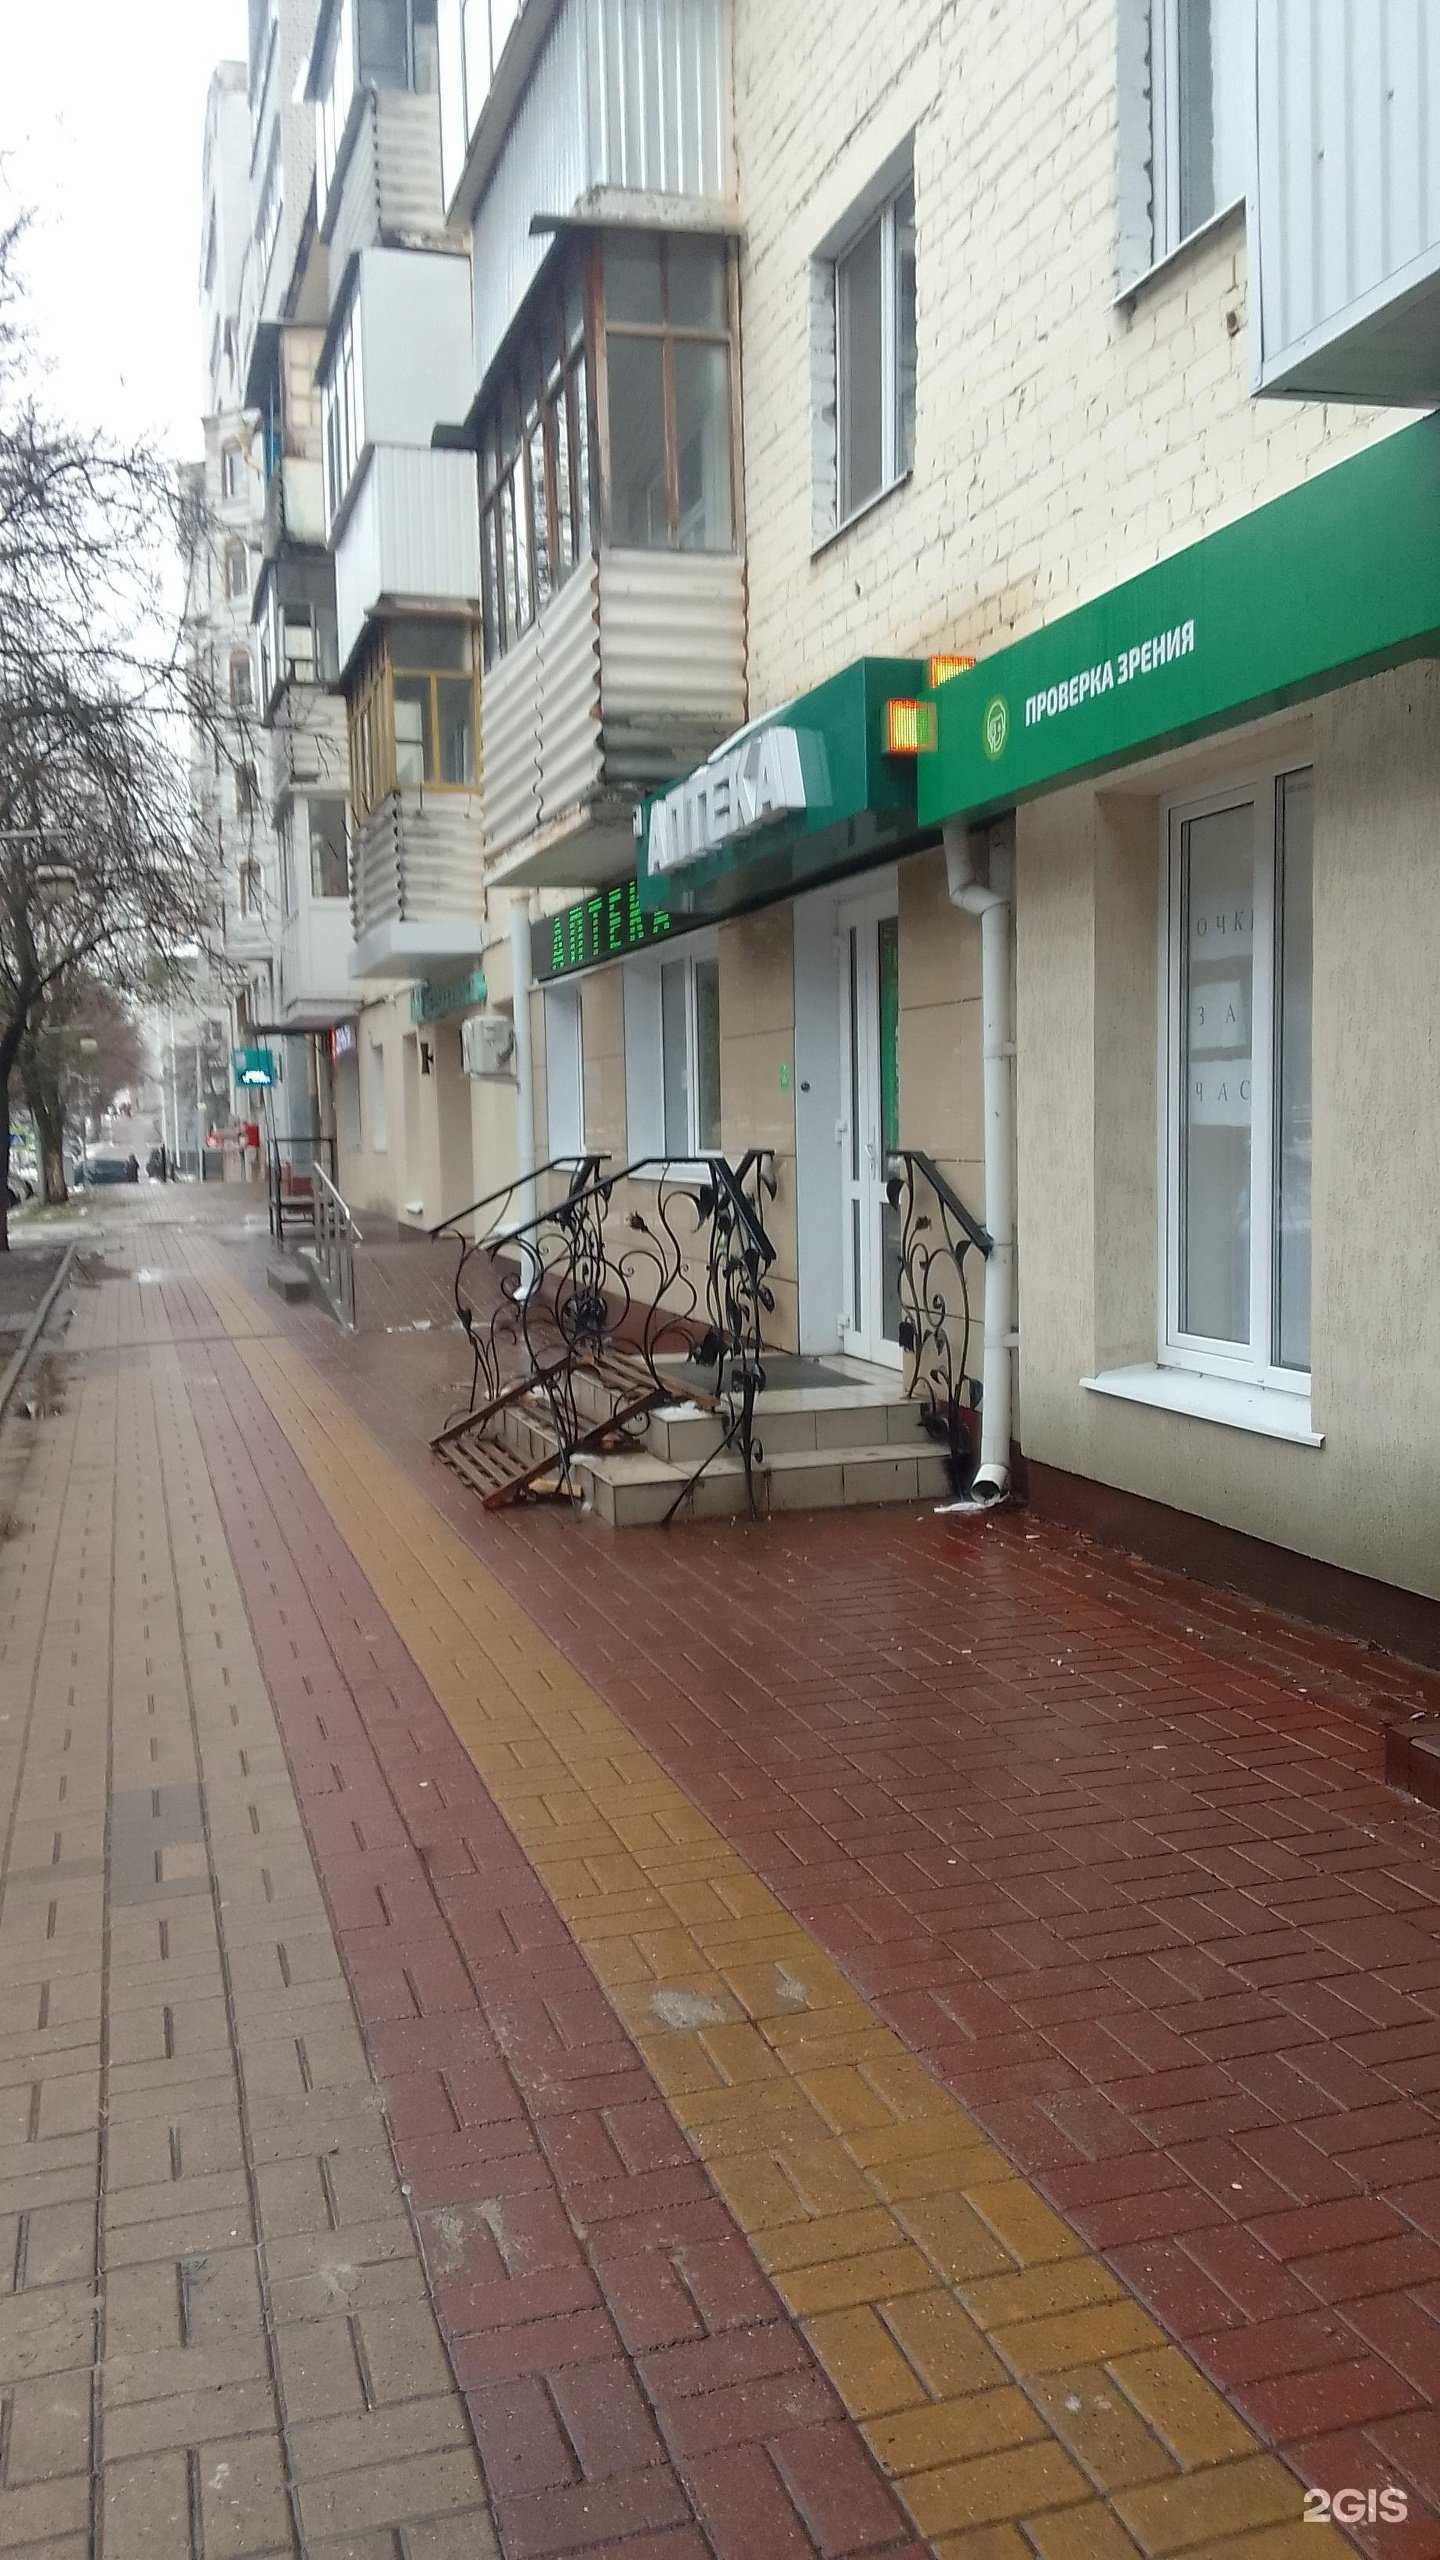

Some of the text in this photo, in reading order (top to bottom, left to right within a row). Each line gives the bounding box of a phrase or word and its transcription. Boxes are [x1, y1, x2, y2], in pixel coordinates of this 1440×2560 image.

[1024, 618, 1195, 727] ПРОВЕРКА ЗРЕНИЯ
[648, 727, 806, 876] АПТЕКА
[1198, 1000, 1236, 1026] ЗА
[1195, 1079, 1250, 1102] ЧАС
